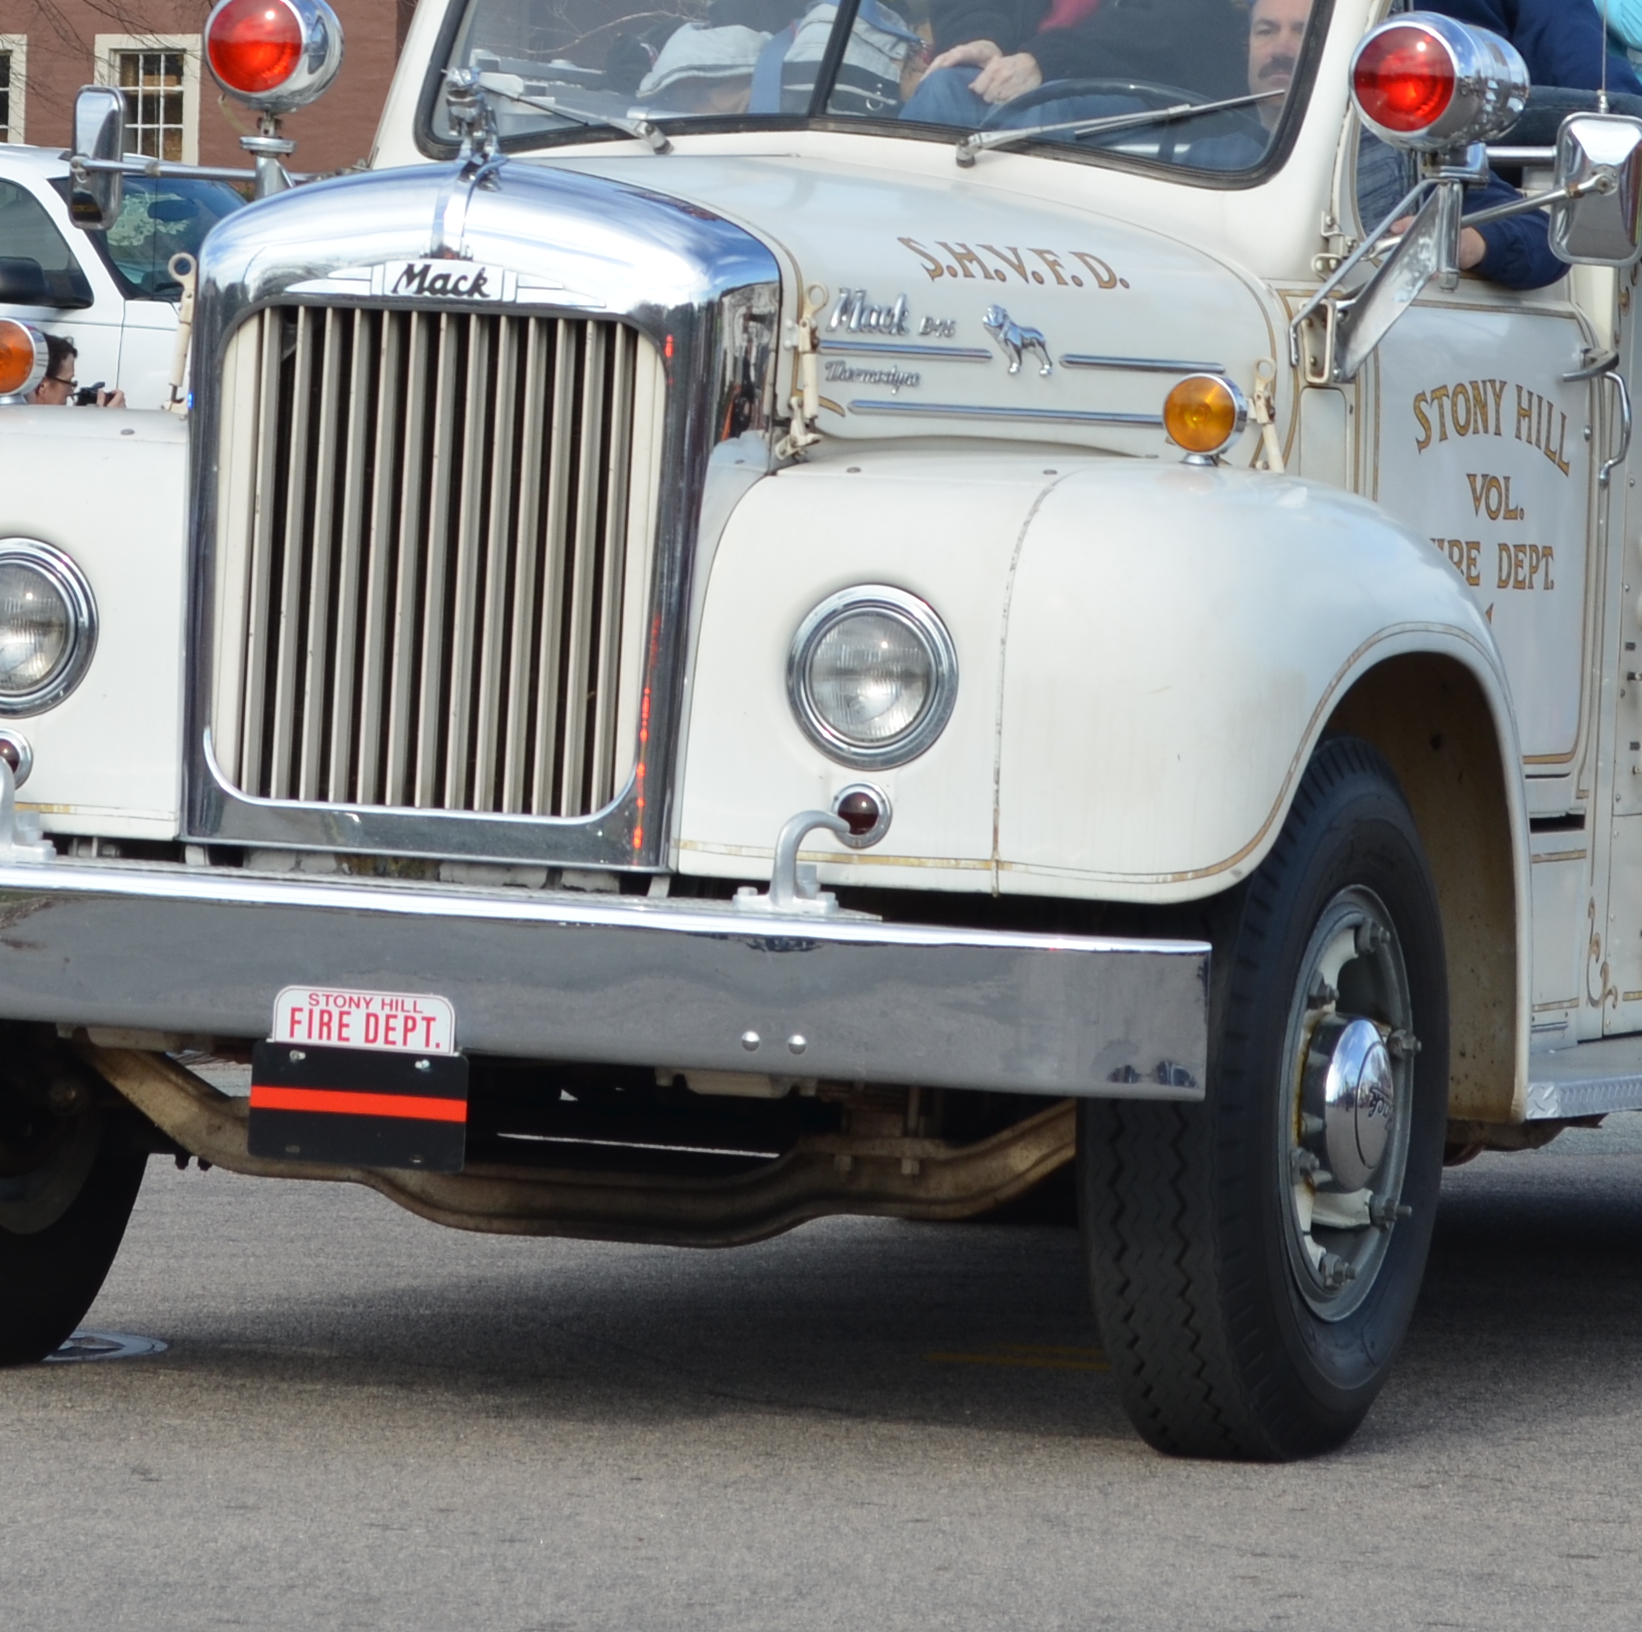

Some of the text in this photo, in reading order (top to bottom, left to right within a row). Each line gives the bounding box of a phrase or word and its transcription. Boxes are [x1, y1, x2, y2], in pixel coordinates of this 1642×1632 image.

[391, 264, 491, 298] Mack
[897, 237, 1130, 289] S.H.V.F.D.
[826, 287, 910, 335] Mack
[1413, 379, 1570, 477] STONY HILL
[1466, 473, 1525, 520] VOL.
[1430, 538, 1555, 590] RE DEPT.
[308, 992, 424, 1014] STONY HILL
[289, 1006, 441, 1049] FIRE DEPT.
